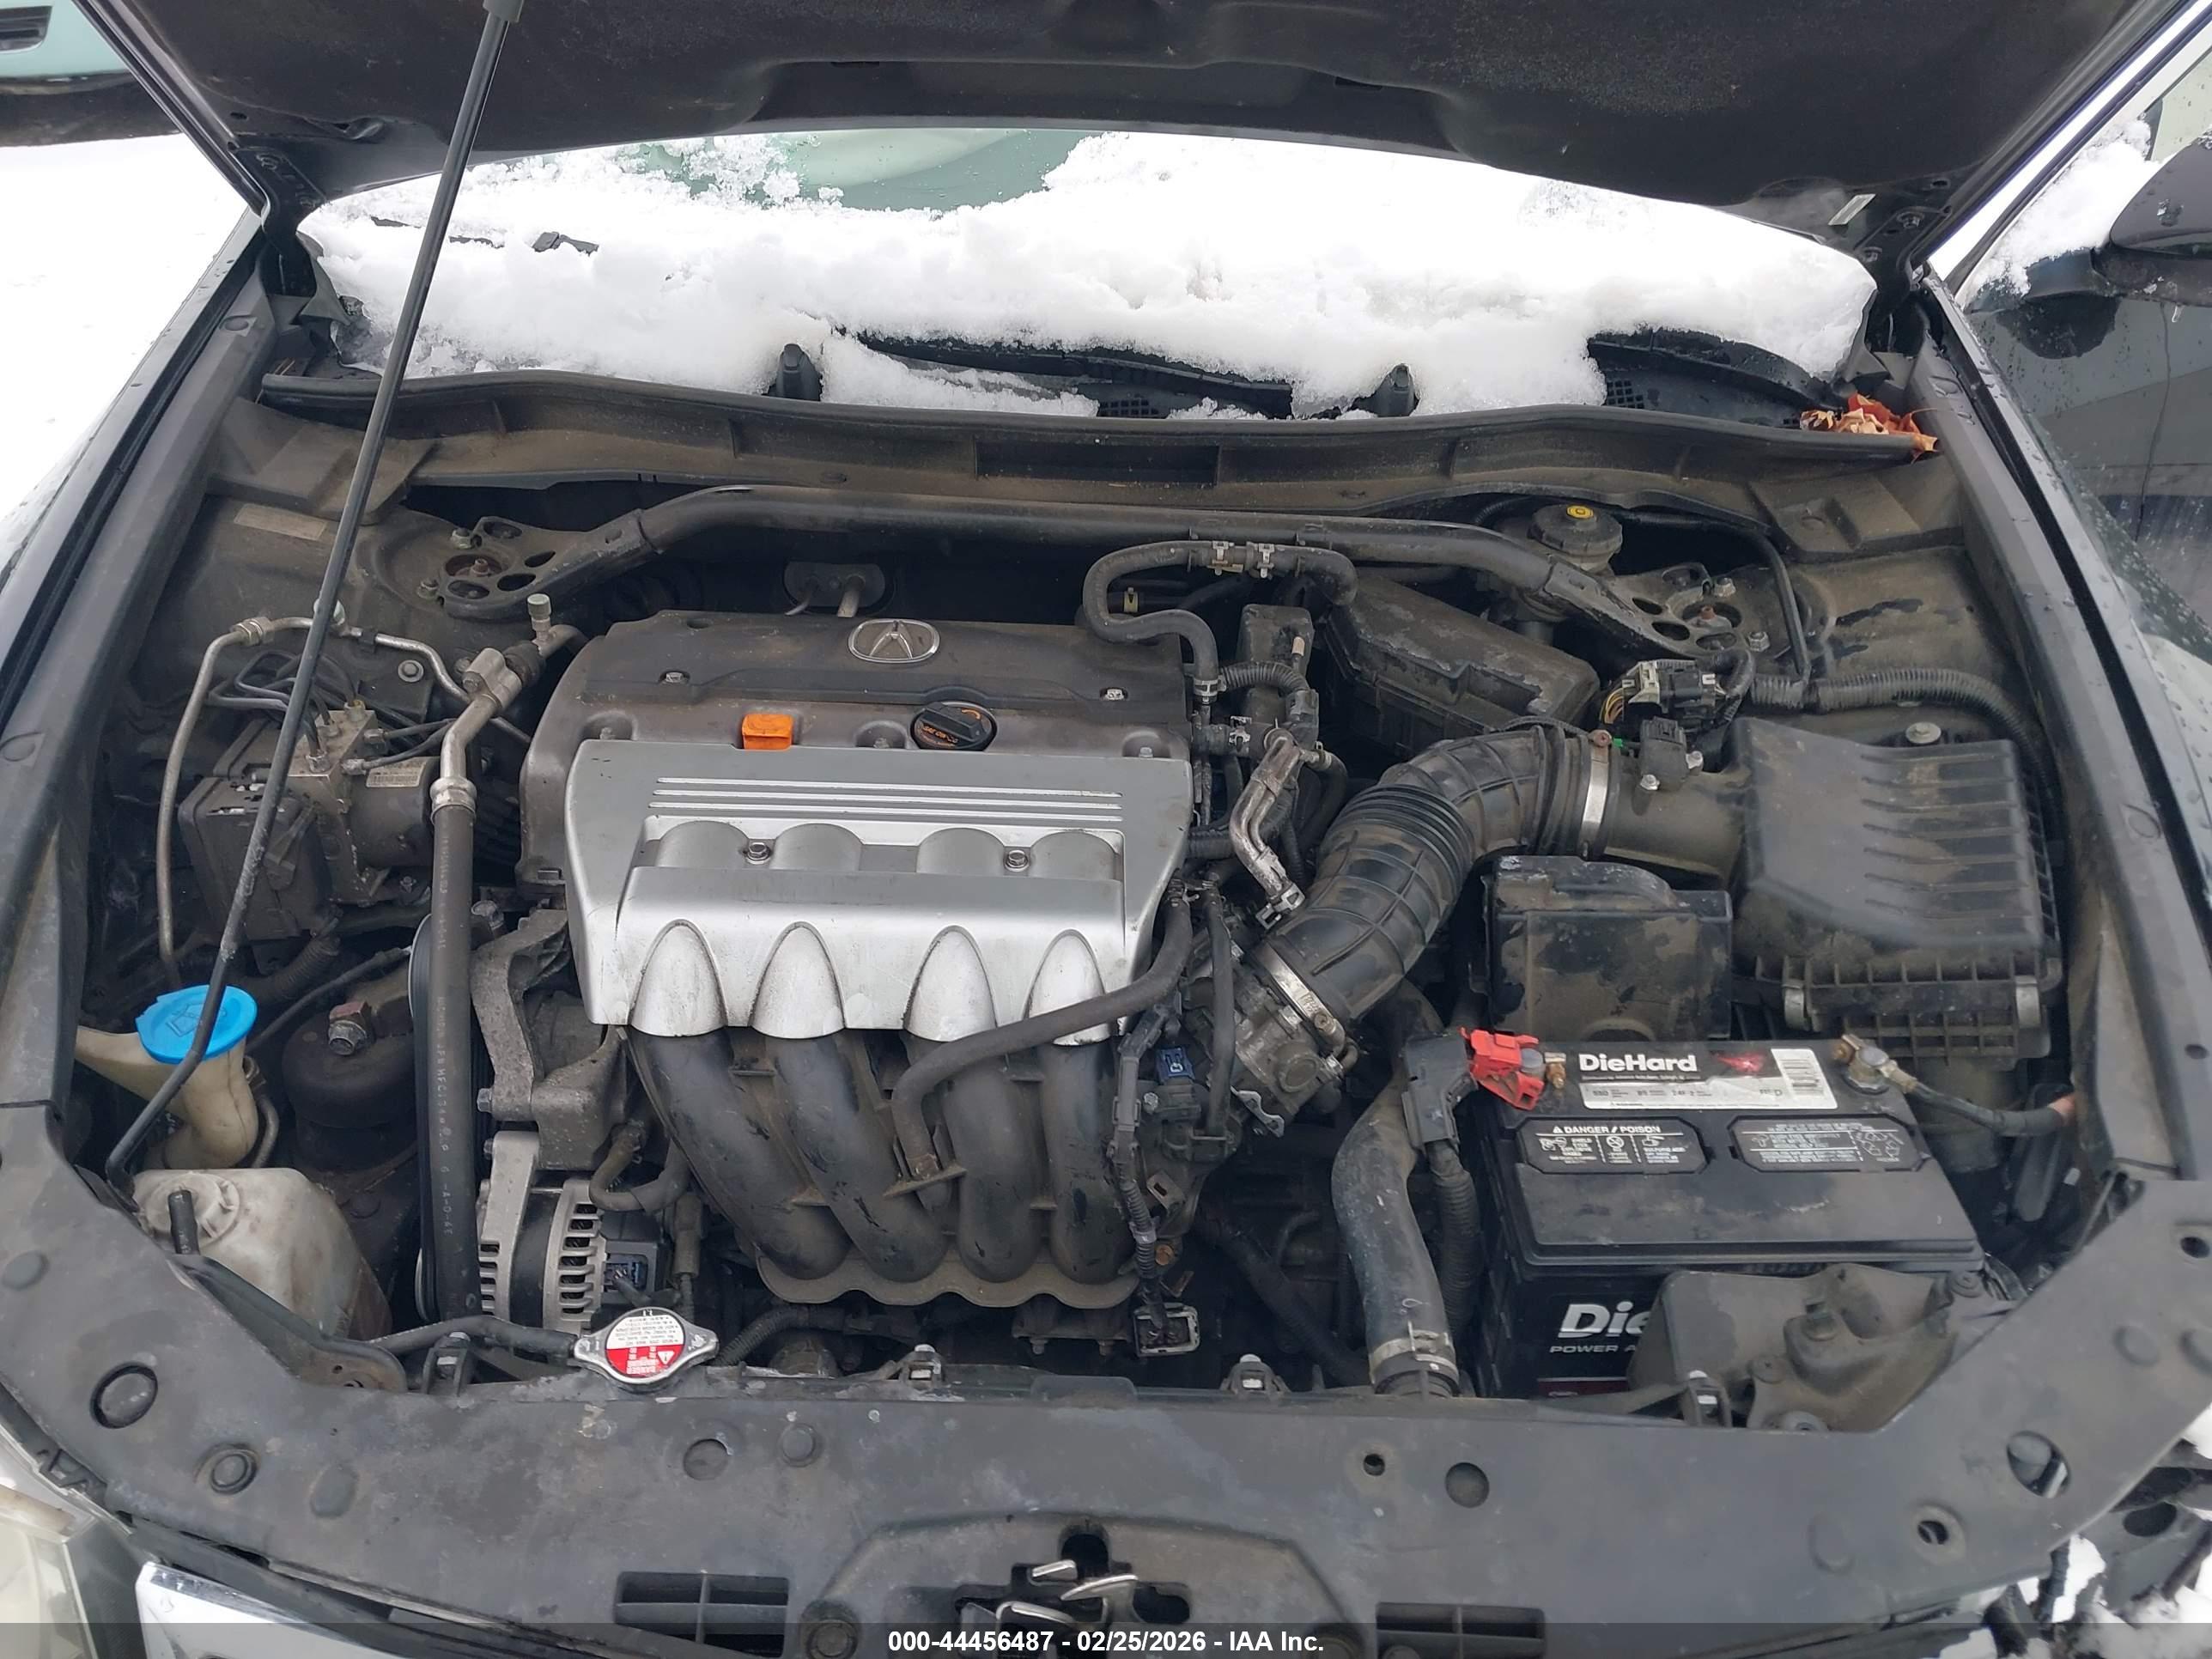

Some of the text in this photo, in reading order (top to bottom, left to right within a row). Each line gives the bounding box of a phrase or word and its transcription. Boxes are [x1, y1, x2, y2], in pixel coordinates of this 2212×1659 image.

[1578, 1054, 1698, 1072] DieHard
[1564, 1125, 1608, 1134] DANGER
[1620, 1125, 1662, 1134] POISON
